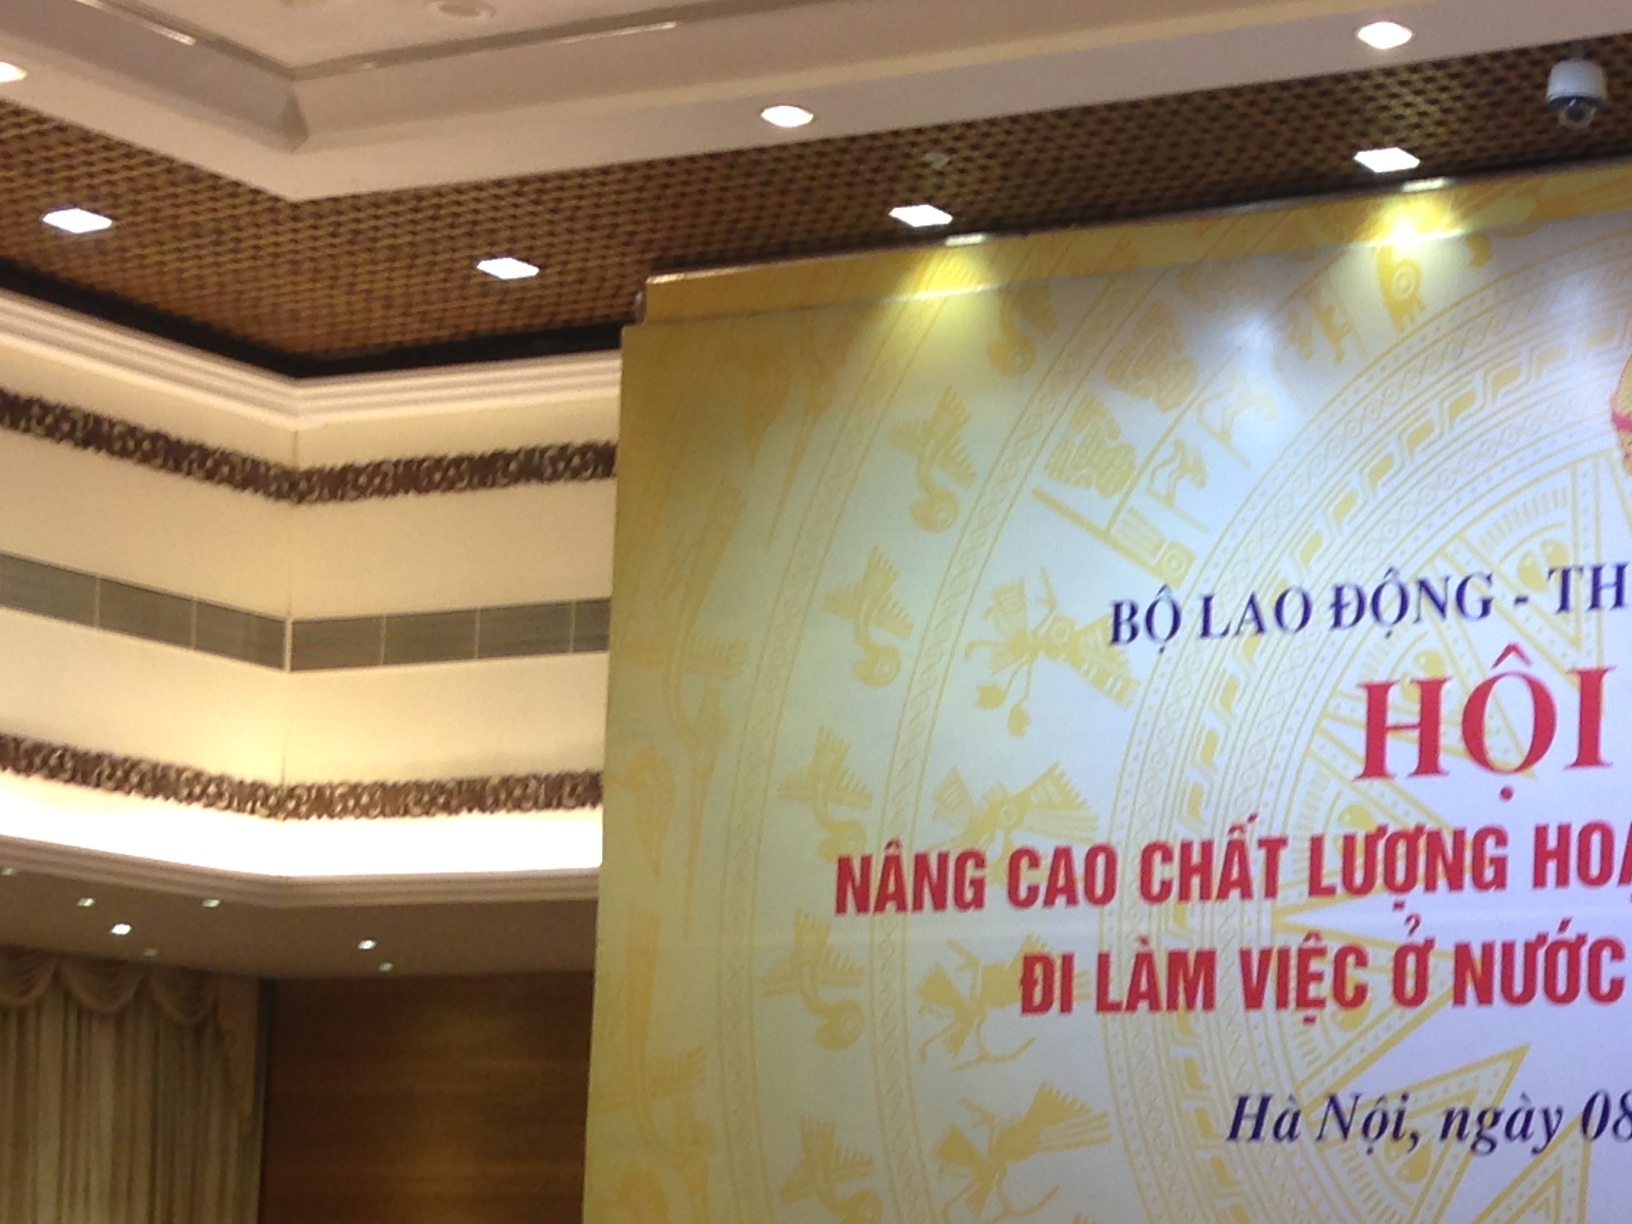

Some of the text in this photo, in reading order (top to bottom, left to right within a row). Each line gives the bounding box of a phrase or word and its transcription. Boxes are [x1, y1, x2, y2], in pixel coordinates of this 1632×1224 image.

[1110, 585, 1182, 653] BỘ
[1199, 588, 1312, 639] LAO
[1330, 566, 1493, 638] ĐỘNG
[1354, 642, 1613, 800] HỘI
[835, 840, 987, 914] NÂNG
[1007, 843, 1118, 909] CAO
[1139, 813, 1289, 905] CHẤT
[1308, 824, 1509, 910] LƯỢNG
[1019, 952, 1075, 1015] ĐI
[1096, 938, 1217, 1014] LÀM
[1239, 931, 1369, 1025] VIỆC
[1392, 915, 1436, 1009] Ở
[1452, 919, 1626, 1007] NƯỚC
[1223, 1092, 1302, 1144] Hà
[1313, 1092, 1421, 1157] Nội,
[1438, 1091, 1564, 1157] ngày
